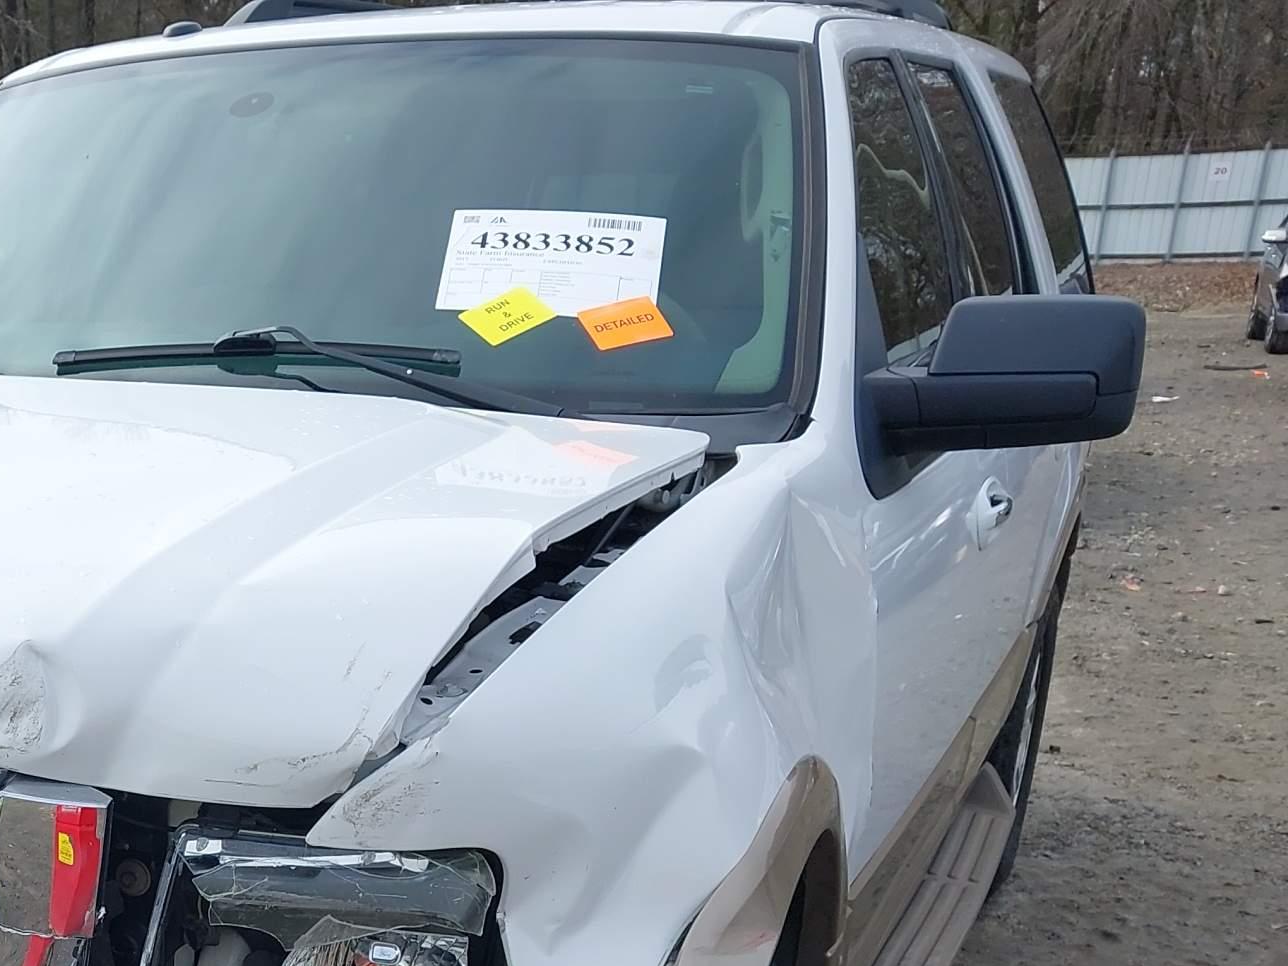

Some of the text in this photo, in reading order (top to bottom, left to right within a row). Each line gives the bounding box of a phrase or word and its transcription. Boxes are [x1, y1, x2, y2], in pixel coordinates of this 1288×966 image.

[1214, 167, 1228, 175] 20
[471, 231, 635, 257] 43833852
[485, 299, 510, 314] RUN
[503, 310, 512, 319] &
[498, 311, 535, 333] DRIVE
[593, 312, 655, 334] DETAILED
